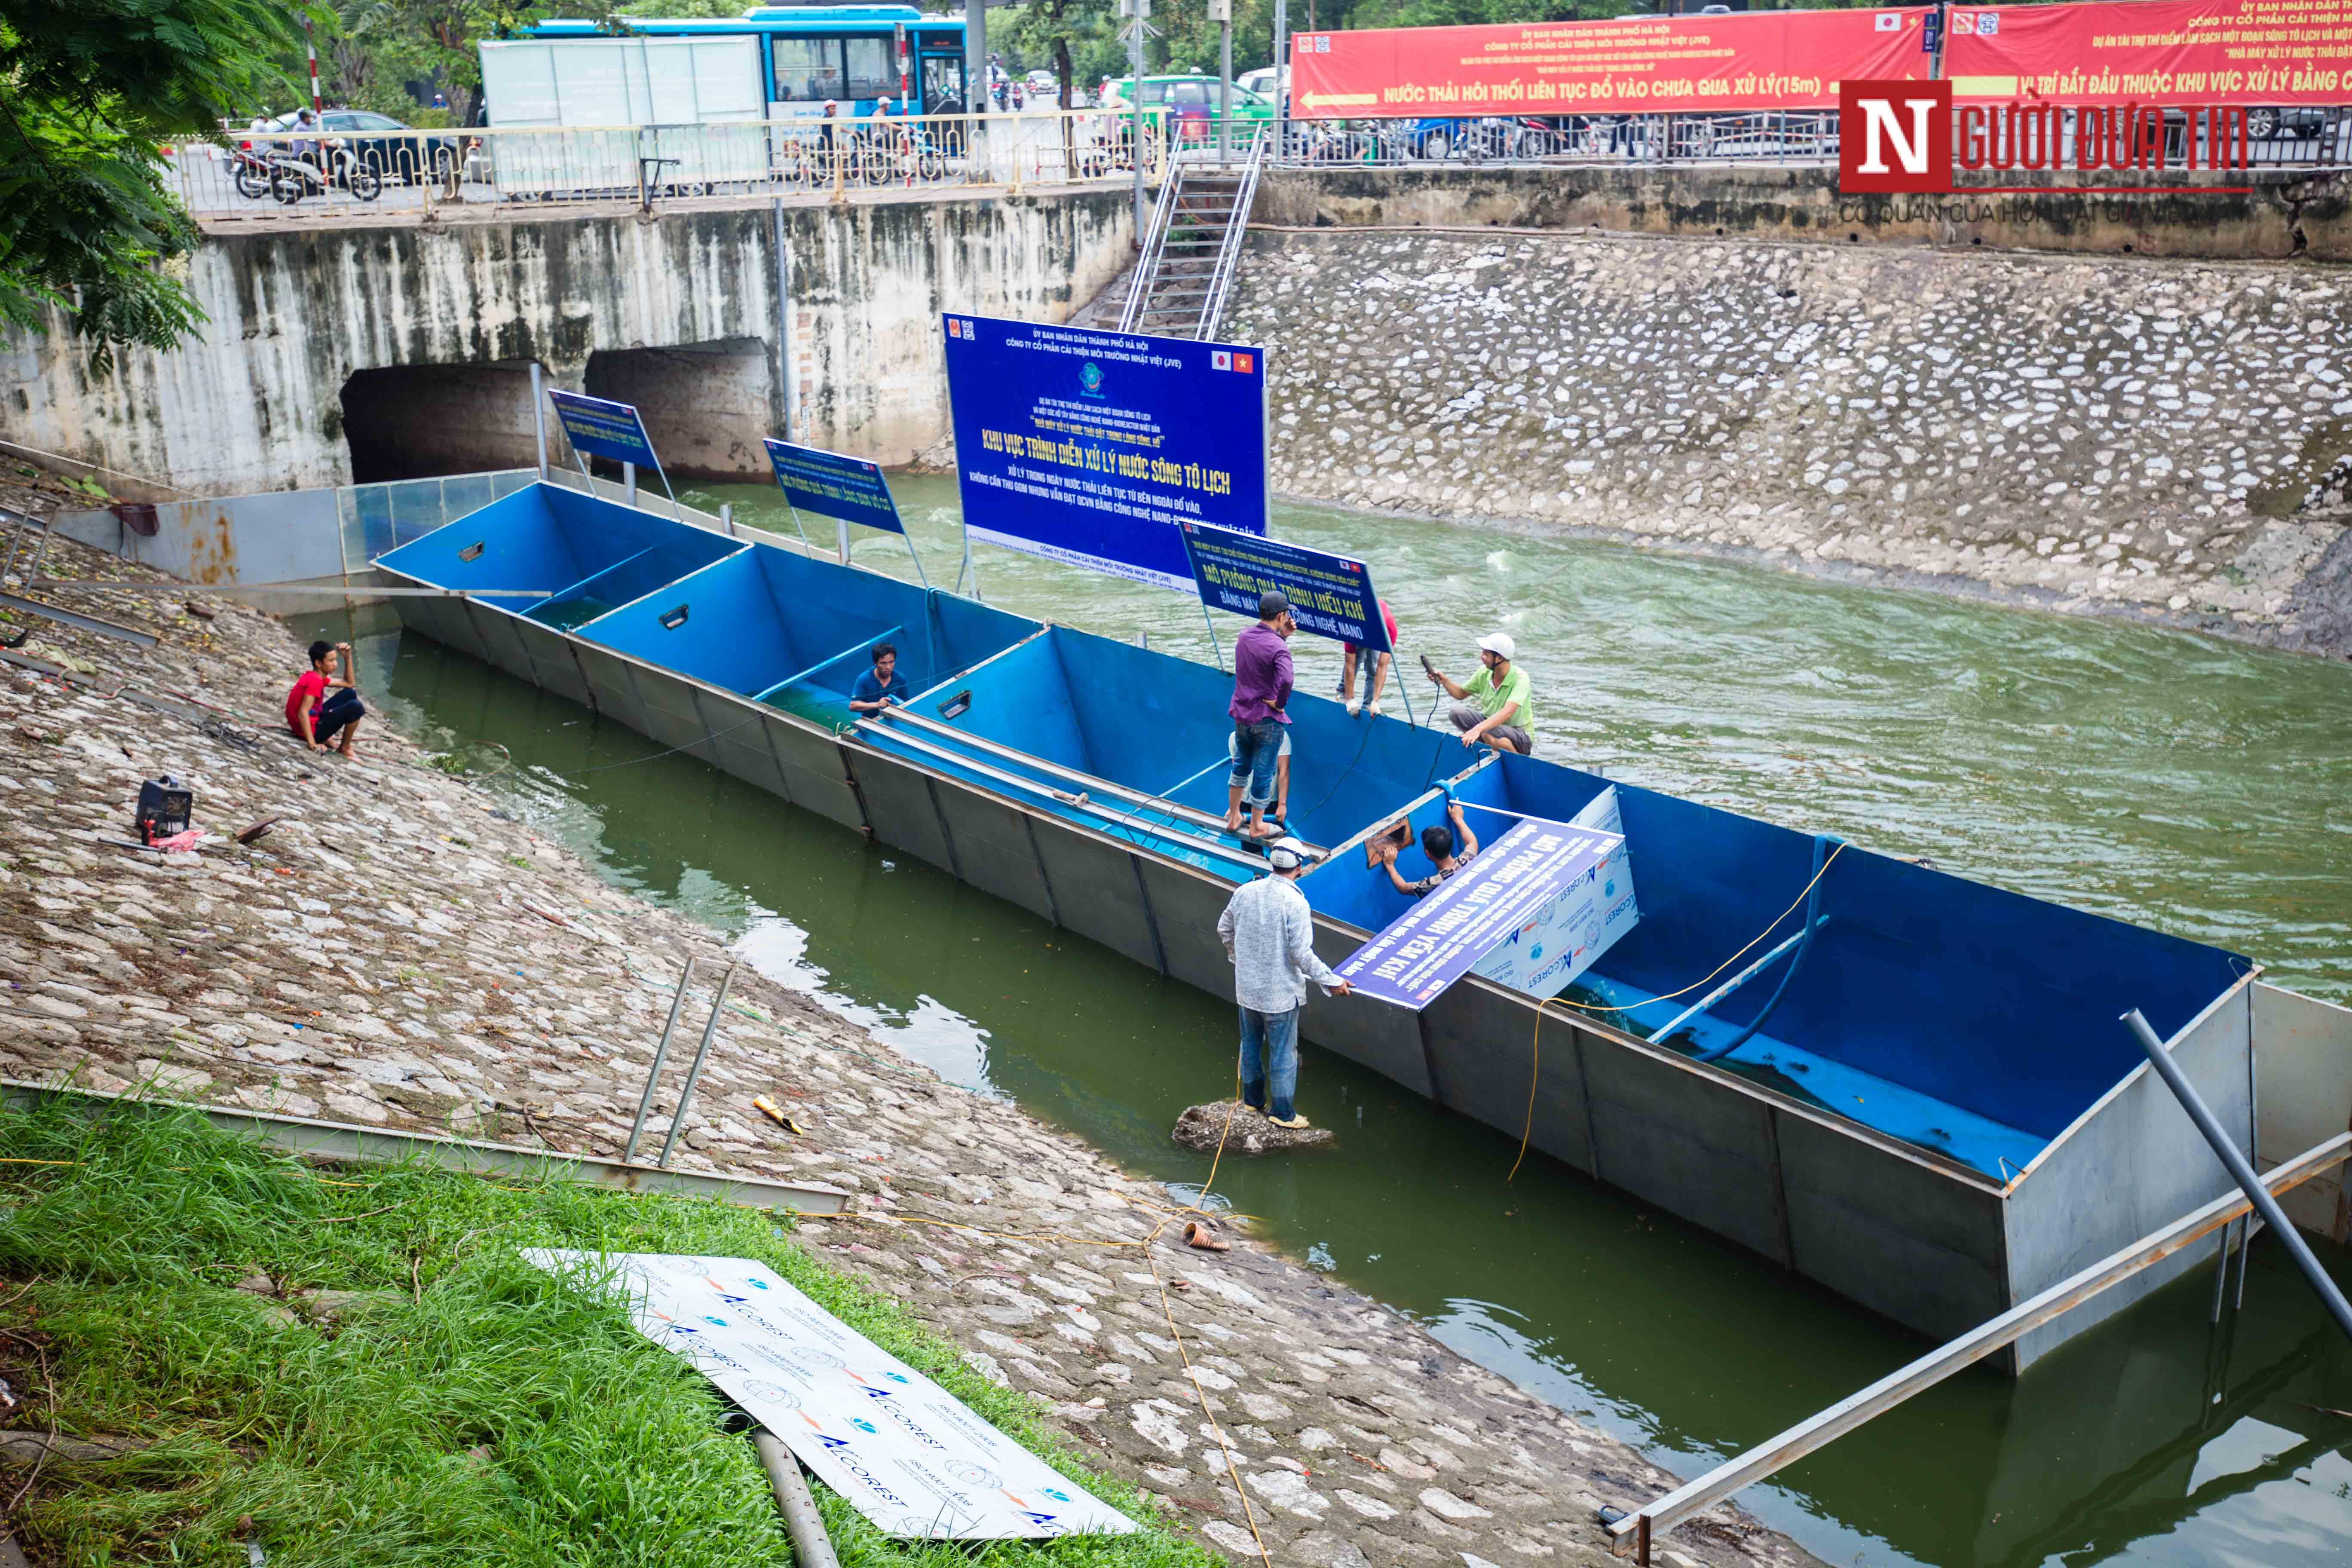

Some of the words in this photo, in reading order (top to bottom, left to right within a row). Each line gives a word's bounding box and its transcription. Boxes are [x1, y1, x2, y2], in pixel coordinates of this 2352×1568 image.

[2188, 16, 2220, 27] CÔNG
[2222, 17, 2235, 26] TY
[2255, 13, 2285, 25] PHẦN
[2310, 11, 2340, 25] THIỆN
[2257, 3, 2279, 12] BAN
[1384, 82, 1426, 103] NƯỚC
[1426, 80, 1459, 102] THẢI
[1461, 80, 1488, 101] HÔI
[1490, 77, 1524, 101] THỐI
[1526, 78, 1555, 100] LIÊN
[1559, 83, 1586, 102] TỤC
[1589, 73, 1613, 99] ĐỔ
[1615, 77, 1649, 98] VÀO
[1651, 78, 1695, 98] CHƯA
[1697, 77, 1730, 96] QUA
[1733, 71, 1755, 95] XỬ
[2037, 70, 2058, 95] TRÍ
[2059, 65, 2087, 95] BẮT
[2088, 64, 2119, 95] ĐẦU
[2122, 68, 2172, 98] THUỘC
[2175, 72, 2206, 93] KHU
[2210, 68, 2242, 96] VỰC
[2245, 64, 2270, 91] XỬ
[2271, 65, 2290, 91] LÝ
[2291, 59, 2338, 92] BẰNG
[1006, 337, 1023, 348] CÔNG
[1032, 338, 1042, 351] CỔ
[1043, 340, 1059, 352] PHẦN
[1072, 345, 1089, 358] THIỆN
[1090, 348, 1102, 358] MÔI
[1103, 349, 1130, 362] TRƯỜNG
[1130, 352, 1148, 366] NHẬT
[1149, 354, 1162, 368] VIỆT
[1164, 358, 1182, 370] (JVE)
[1041, 331, 1054, 340] BAN
[1055, 331, 1073, 342] NHÂN
[1074, 333, 1087, 344] DÂN
[1088, 334, 1109, 346] THÀNH
[1110, 336, 1124, 348] PHỐ
[1125, 339, 1135, 349] HÀ
[1136, 340, 1148, 353] NỘI
[982, 429, 1003, 452] KHU
[1003, 432, 1024, 460] VỰC
[1025, 433, 1057, 462] TRÌNH
[1058, 434, 1083, 468] DIỄN
[1084, 442, 1100, 471] XỬ
[1102, 447, 1116, 474] LÝ
[1118, 449, 1149, 481] NƯỚC
[1151, 455, 1182, 487] SÔNG
[1183, 460, 1200, 490] TÔ
[1203, 468, 1230, 499] LỊCH
[969, 470, 989, 485] KHÔNG
[989, 473, 1001, 488] CẦN
[1002, 478, 1014, 491] THU
[1014, 481, 1027, 494] GOM
[1050, 485, 1063, 502] VẪN
[1063, 492, 1076, 506] ĐẠT
[1077, 495, 1094, 508] QCVN
[1095, 495, 1113, 512] BẰNG
[1114, 501, 1132, 517] CÔNG
[1133, 504, 1151, 522] NGHỆ
[1008, 463, 1017, 477] XỬ
[1018, 466, 1025, 478] LÝ
[1026, 469, 1045, 483] TRONG
[1046, 471, 1063, 486] NGÀY
[1064, 475, 1081, 491] NƯỚC
[1082, 478, 1097, 494] THẢI
[1097, 483, 1112, 497] LIÊN
[1113, 487, 1127, 502] TỤC
[1137, 490, 1151, 505] BÊN
[1152, 494, 1173, 509] NGOÀI
[1174, 496, 1184, 511] ĐỔ
[1202, 563, 1221, 584] MÔ
[1220, 567, 1257, 594] PHỎNG
[1279, 583, 1314, 608] TRÌNH
[1314, 591, 1342, 616] HIẾU
[1342, 599, 1366, 622] KHÍ
[1219, 586, 1243, 608] BẰNG
[1241, 596, 1259, 613] MÁY
[1314, 615, 1339, 636] NGHỆ
[1338, 621, 1364, 640] NANO
[1530, 834, 1563, 853] MÔ
[1490, 850, 1549, 885] PHỎNG
[1461, 880, 1509, 906] QUÁ
[1606, 894, 1635, 925] LCOREST
[1423, 900, 1483, 938] TRÌNH
[1394, 931, 1446, 963] YẾM
[1371, 956, 1413, 982] KHÍ
[1528, 950, 1572, 988] ALCOREST
[717, 1293, 796, 1341] ALCOREST
[858, 1385, 947, 1451] ALCOREST
[813, 1433, 908, 1507] ALCOREST
